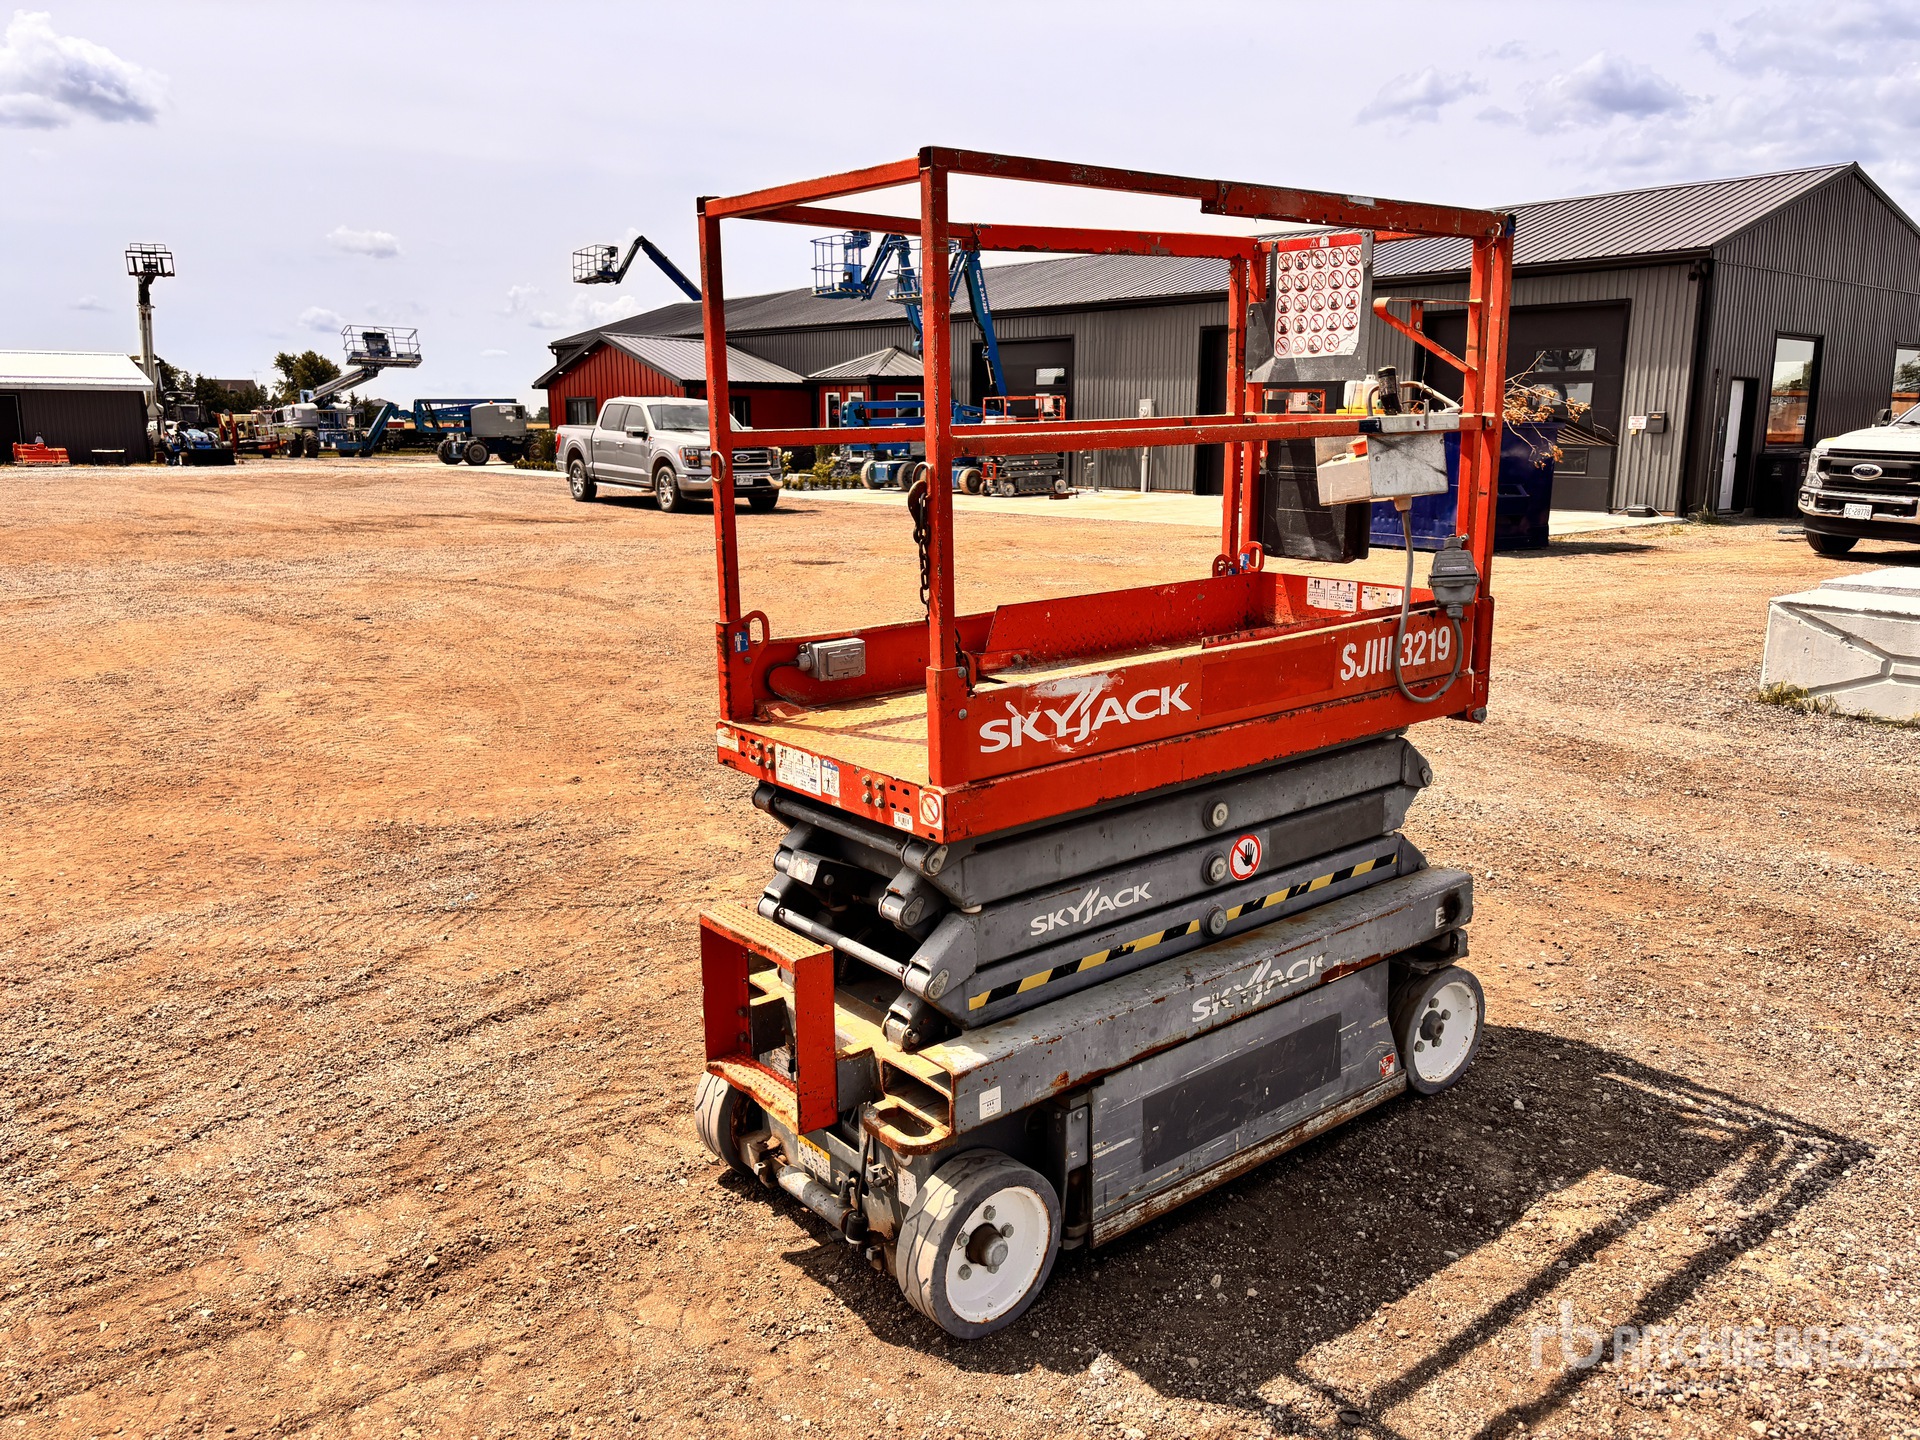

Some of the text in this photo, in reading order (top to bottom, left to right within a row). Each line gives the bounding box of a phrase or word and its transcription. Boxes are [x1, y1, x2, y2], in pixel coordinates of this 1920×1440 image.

[1340, 626, 1451, 681] SJIII 3219
[979, 682, 1192, 753] SKYJACK
[1030, 882, 1152, 936] SKYJACK
[1192, 955, 1326, 1023] SKYJACK
